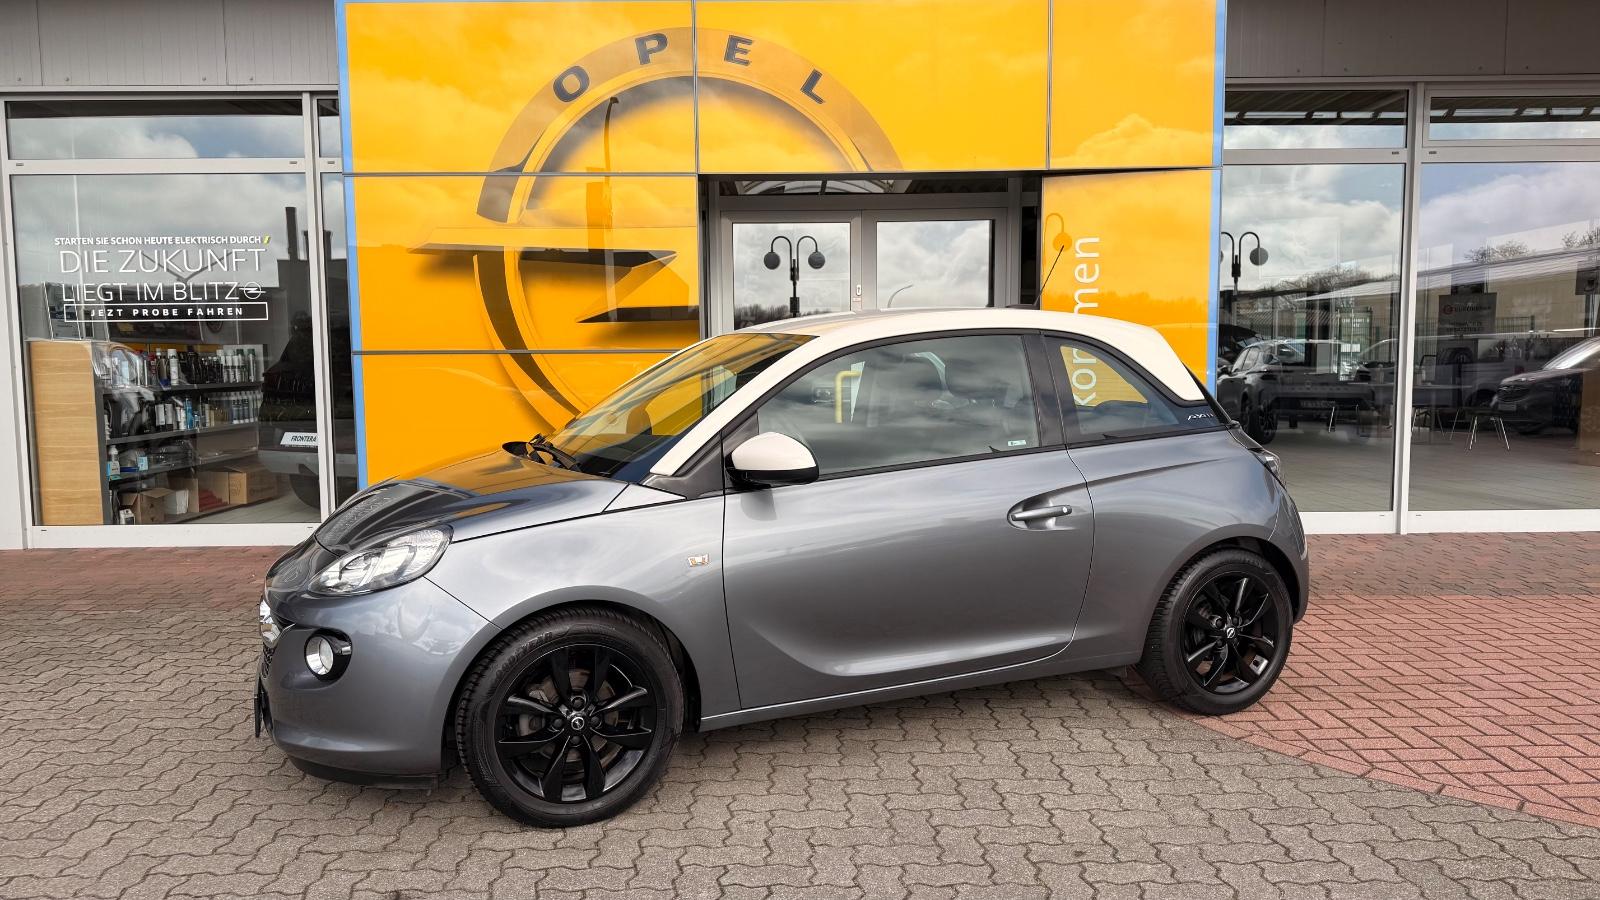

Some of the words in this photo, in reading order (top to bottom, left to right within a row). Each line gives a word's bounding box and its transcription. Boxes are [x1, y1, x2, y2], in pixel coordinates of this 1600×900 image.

[552, 33, 826, 104] OPEL
[54, 237, 94, 245] STARTEN
[95, 237, 110, 245] SIE
[144, 237, 174, 245] HEUTE
[175, 236, 229, 245] ELEKTRISCH
[230, 236, 261, 244] DURCH
[59, 250, 109, 273] DIE
[118, 248, 266, 273] ZUKUNFT
[62, 283, 128, 302] LIEGT
[136, 283, 165, 301] IM
[173, 281, 240, 301] BLITZ
[90, 309, 124, 317] JEZT
[132, 308, 179, 317] PROBE
[187, 307, 244, 316] FAHREN
